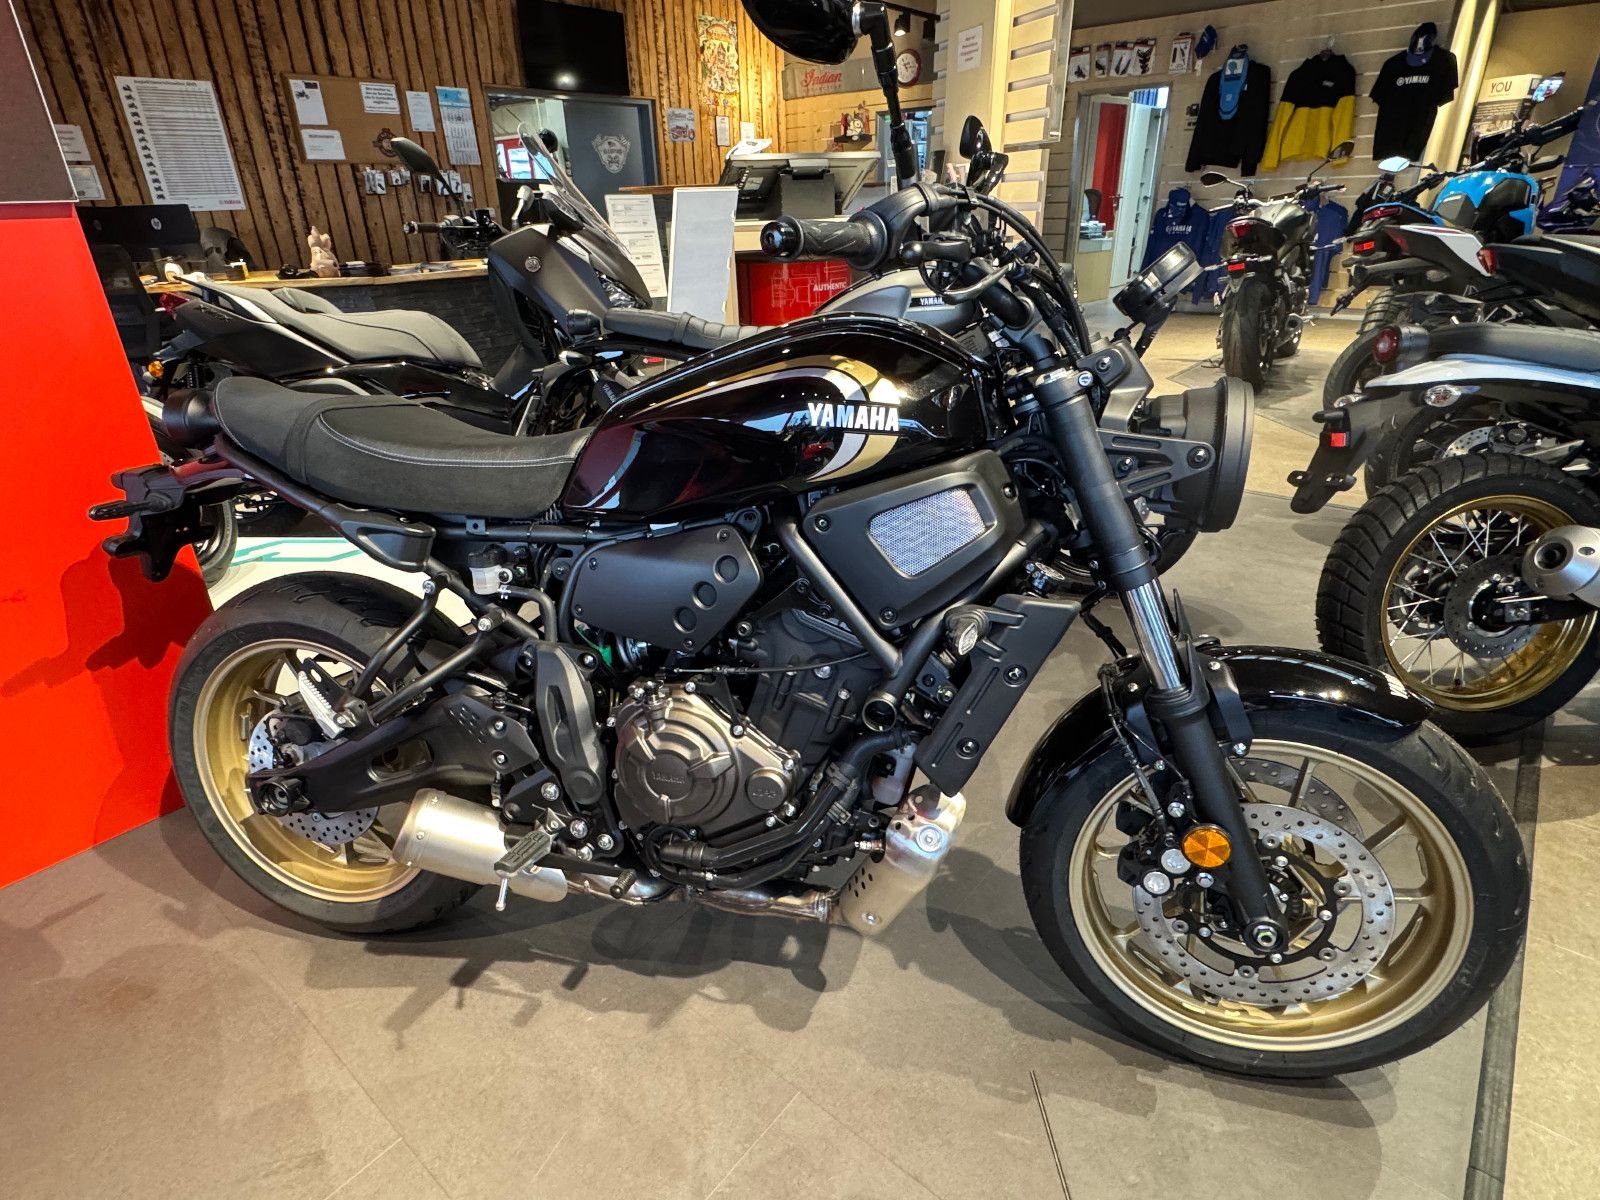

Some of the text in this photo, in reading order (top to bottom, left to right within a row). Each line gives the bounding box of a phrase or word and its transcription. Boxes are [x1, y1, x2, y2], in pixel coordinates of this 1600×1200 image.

[1491, 81, 1513, 94] YOU
[920, 297, 944, 306] YAMAH
[807, 402, 900, 432] YAMAHA
